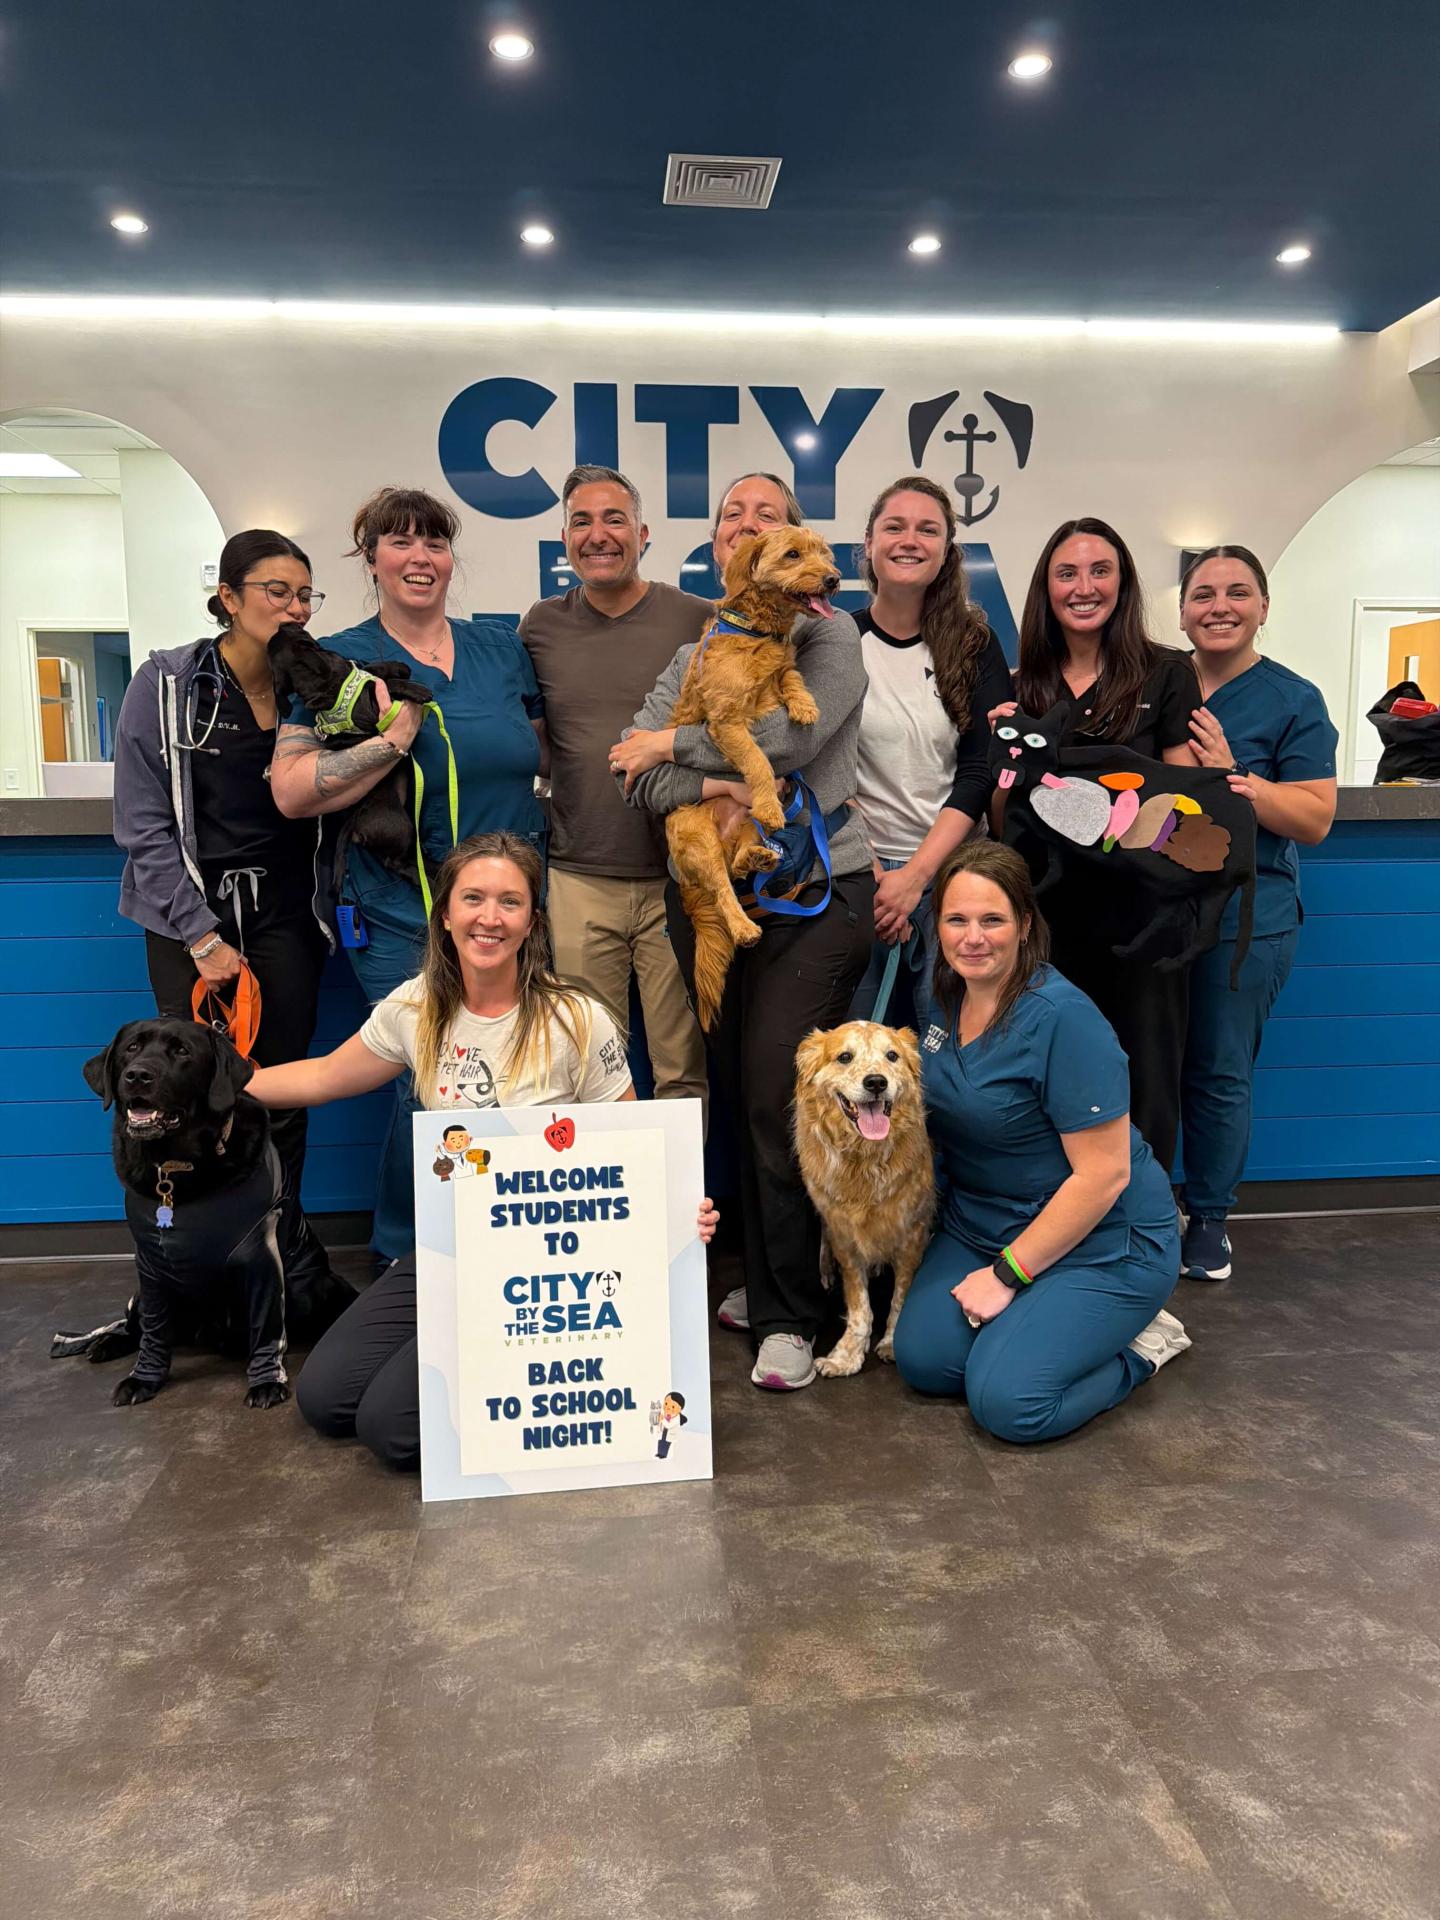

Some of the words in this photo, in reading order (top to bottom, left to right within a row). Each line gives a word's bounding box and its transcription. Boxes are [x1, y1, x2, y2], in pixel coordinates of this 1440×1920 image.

[438, 377, 884, 520] CITY
[598, 1036, 615, 1059] CITY
[601, 1050, 617, 1068] THE
[441, 1062, 460, 1075] PET
[495, 1166, 624, 1195] WELCOME
[491, 1197, 630, 1228] STUDENTS
[544, 1231, 579, 1255] TO
[503, 1271, 595, 1305] CITY
[504, 1322, 540, 1336] THE
[542, 1301, 622, 1333] SEA
[516, 1307, 539, 1320] BY
[504, 1331, 623, 1347] VETERINARY
[528, 1358, 604, 1386] BACK
[486, 1396, 521, 1421] TO
[532, 1387, 637, 1418] SCHOOL
[523, 1420, 612, 1450] NIGHT!
